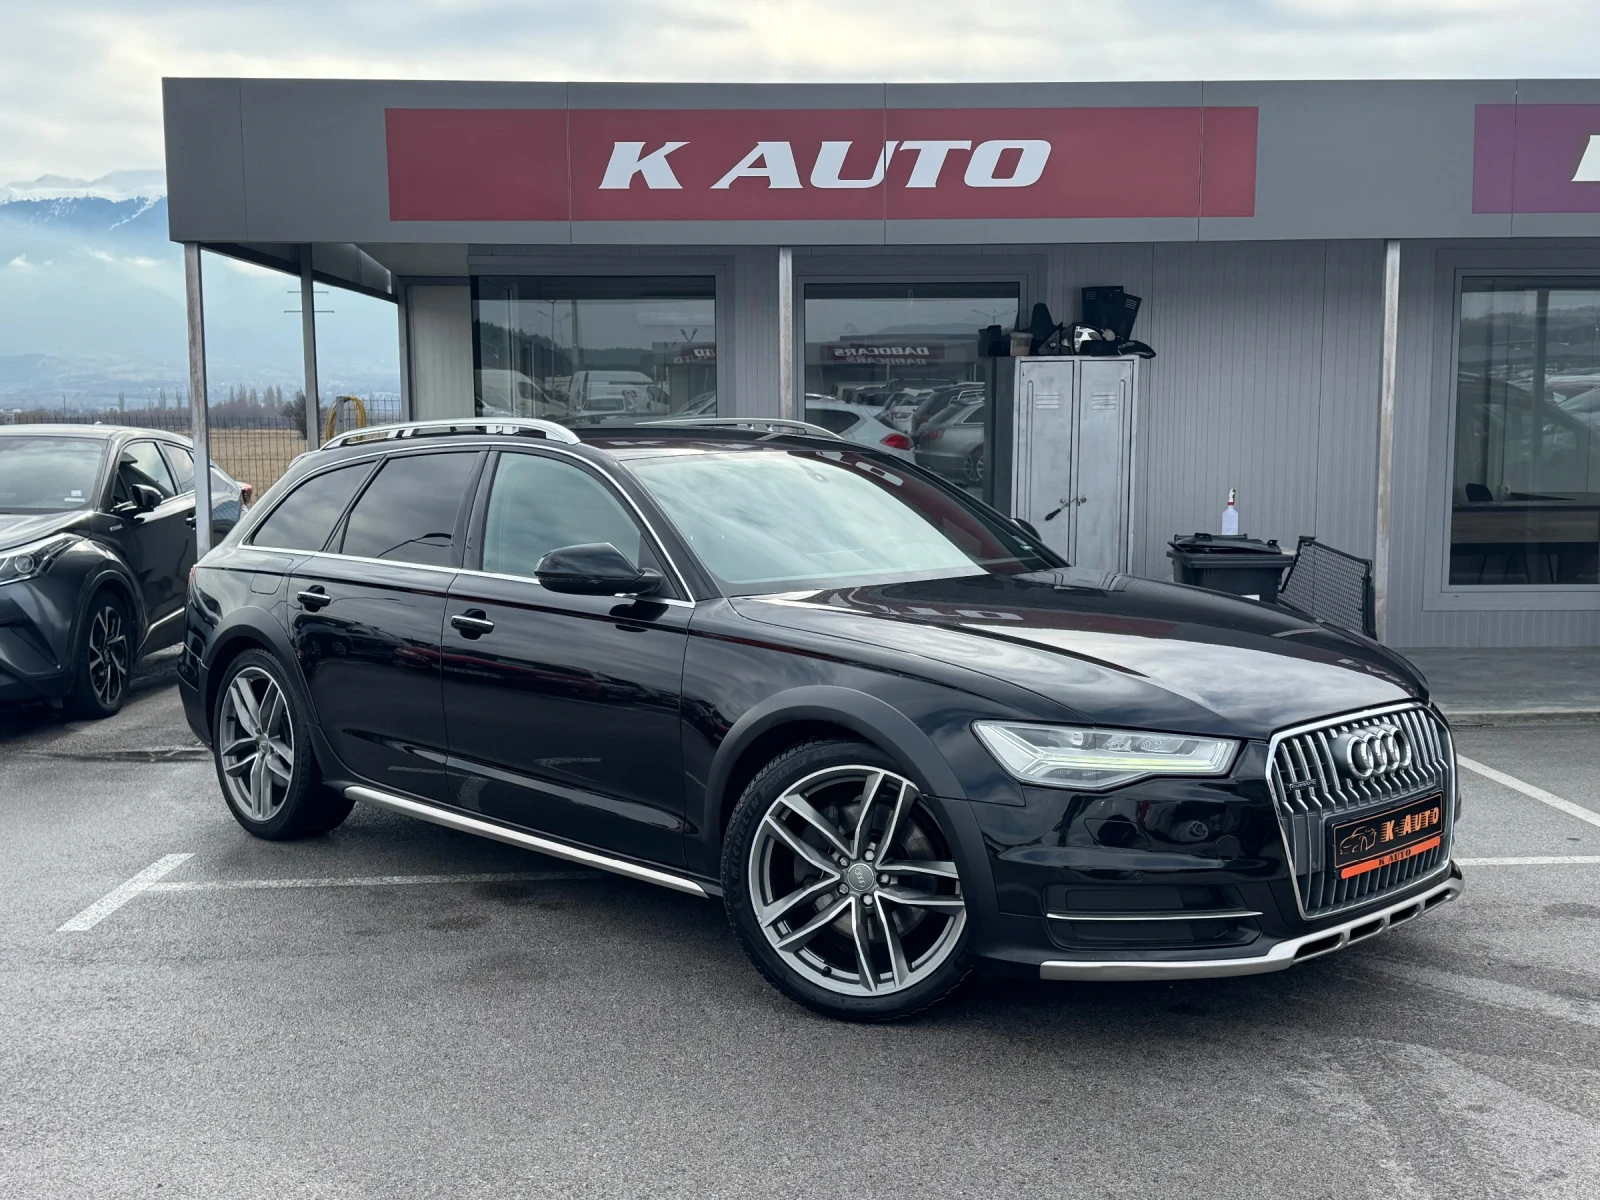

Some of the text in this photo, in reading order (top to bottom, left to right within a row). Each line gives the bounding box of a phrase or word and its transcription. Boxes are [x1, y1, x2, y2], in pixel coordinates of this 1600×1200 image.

[599, 139, 1053, 190] K AUTO
[1378, 849, 1412, 866] K AUTO
